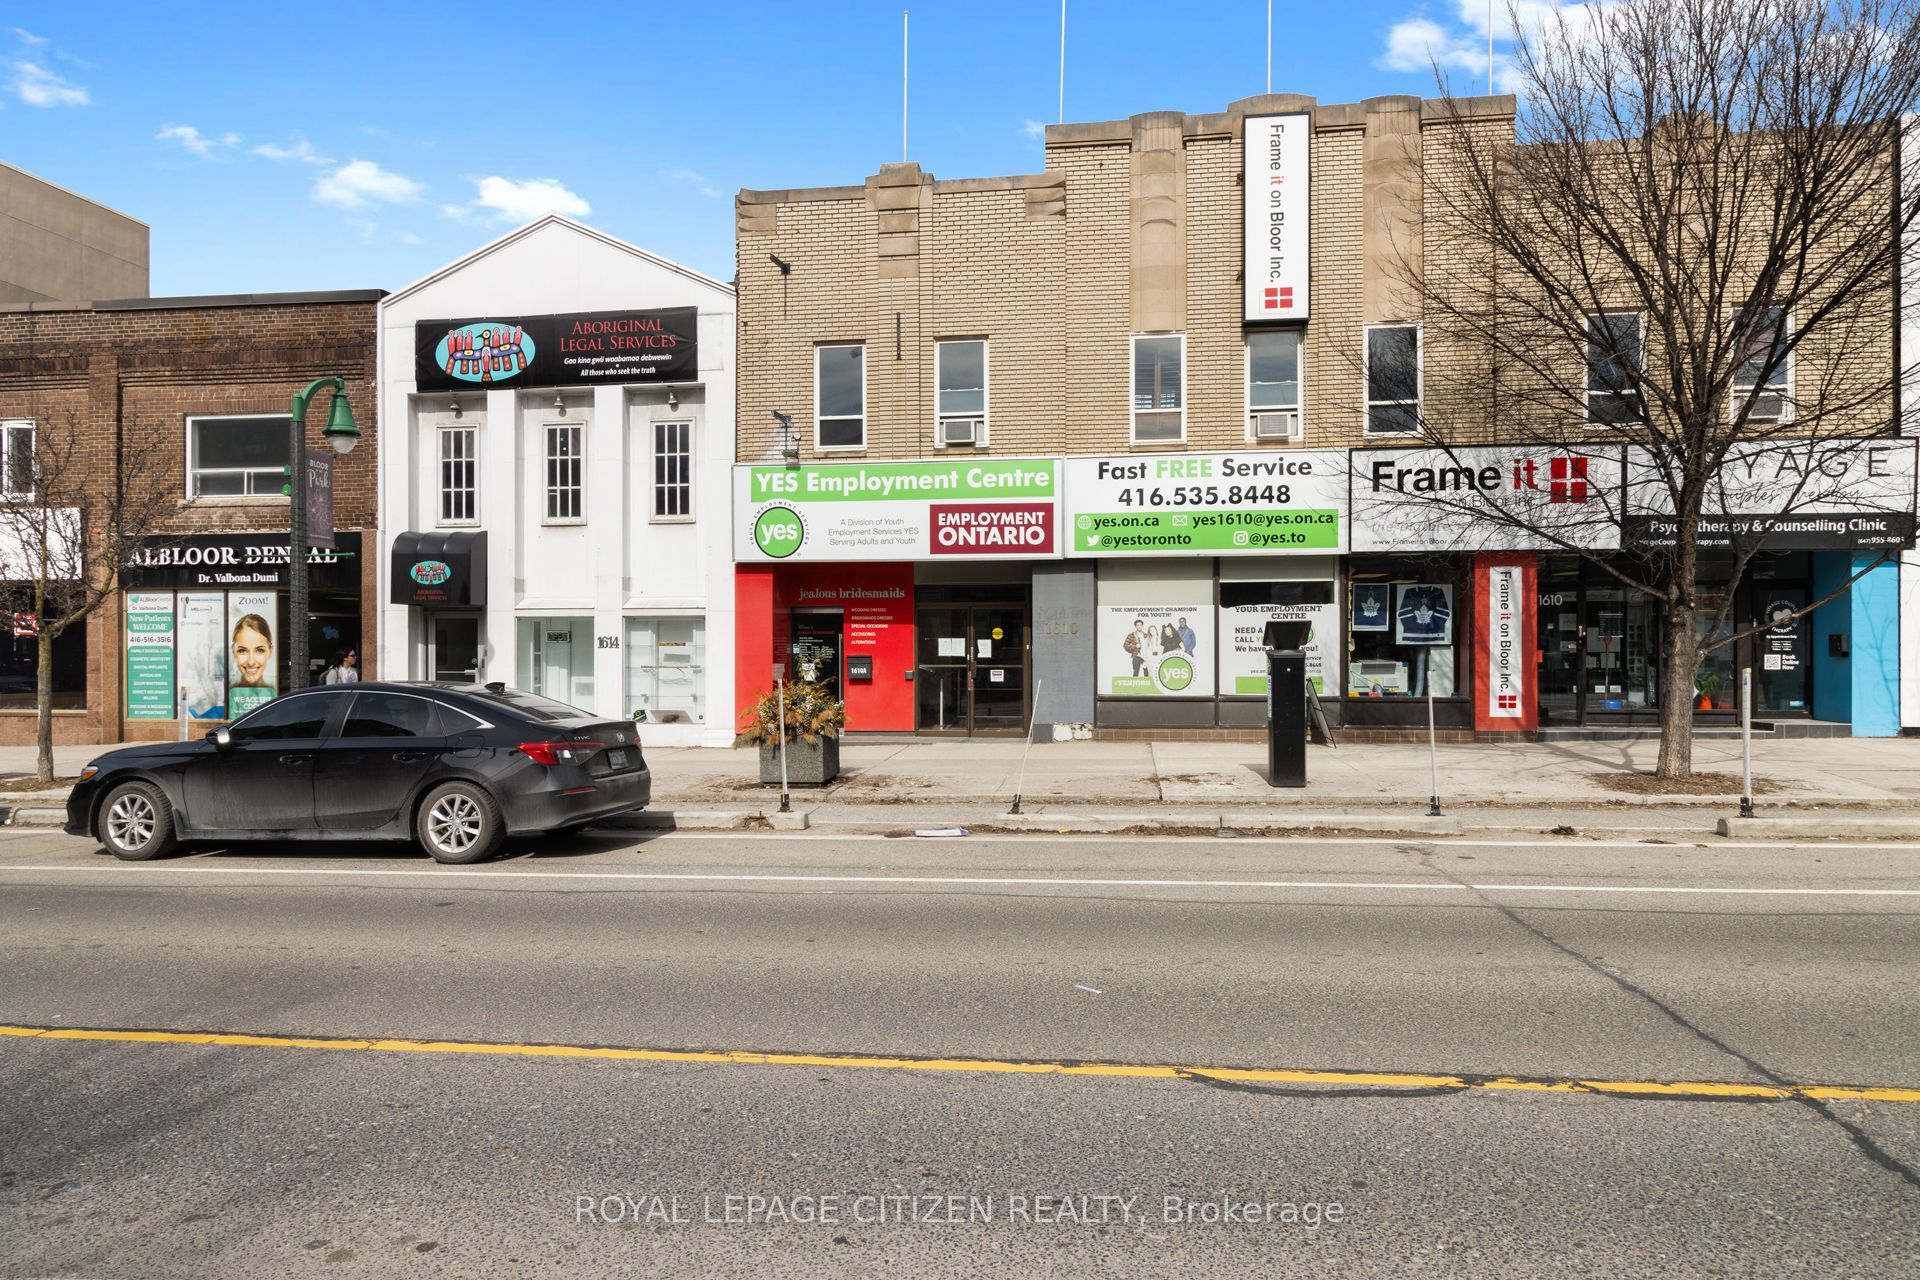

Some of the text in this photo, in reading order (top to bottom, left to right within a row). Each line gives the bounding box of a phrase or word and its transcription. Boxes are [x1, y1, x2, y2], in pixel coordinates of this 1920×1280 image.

[1270, 125, 1284, 283] Frame it on Bloor Inc.
[572, 319, 664, 335] ABORIGINAL
[560, 334, 677, 352] LEGAL SERVICES
[578, 356, 591, 364] kina
[640, 353, 672, 361] debwewin
[580, 369, 589, 377] All
[589, 368, 605, 376] those
[641, 366, 656, 374] truth
[310, 460, 329, 470] BLOOR
[1098, 456, 1313, 480] Fast FREE Service
[756, 467, 1050, 497] YES Employment Centre
[1372, 459, 1539, 492] Frame it
[1118, 484, 1291, 507] 416.535.8448
[753, 501, 796, 519] EMPLOYMENT
[847, 518, 877, 526] Division
[884, 518, 905, 526] Youth
[938, 511, 1045, 526] EMPLOYMENT
[1094, 512, 1334, 531] yes.on.ca yes1610@yes.on.ca
[761, 522, 798, 546] yes
[828, 528, 871, 537] Employment
[904, 527, 920, 535] YES
[1650, 518, 1888, 536] Psyctherapy & Counselling Clinic
[829, 537, 916, 547] Serving Adults and Youth
[938, 525, 1045, 546] ONTARIO
[1101, 531, 1306, 548] @yestoronto @yes.to
[128, 545, 338, 566] ALBLOOR DENAL
[198, 572, 279, 583] Dr. Valbona Dumi
[238, 596, 269, 605] ZOOM!
[798, 587, 905, 601] jealous bridesmaids
[1538, 594, 1563, 606] 1610
[1260, 605, 1322, 613] EMPLOYMENT
[130, 614, 171, 623] New Patients
[132, 623, 168, 631] WELCOME
[1499, 571, 1512, 693] Frame it on Bloor Inc.
[597, 636, 619, 649] 1614
[1163, 667, 1189, 682] yes
